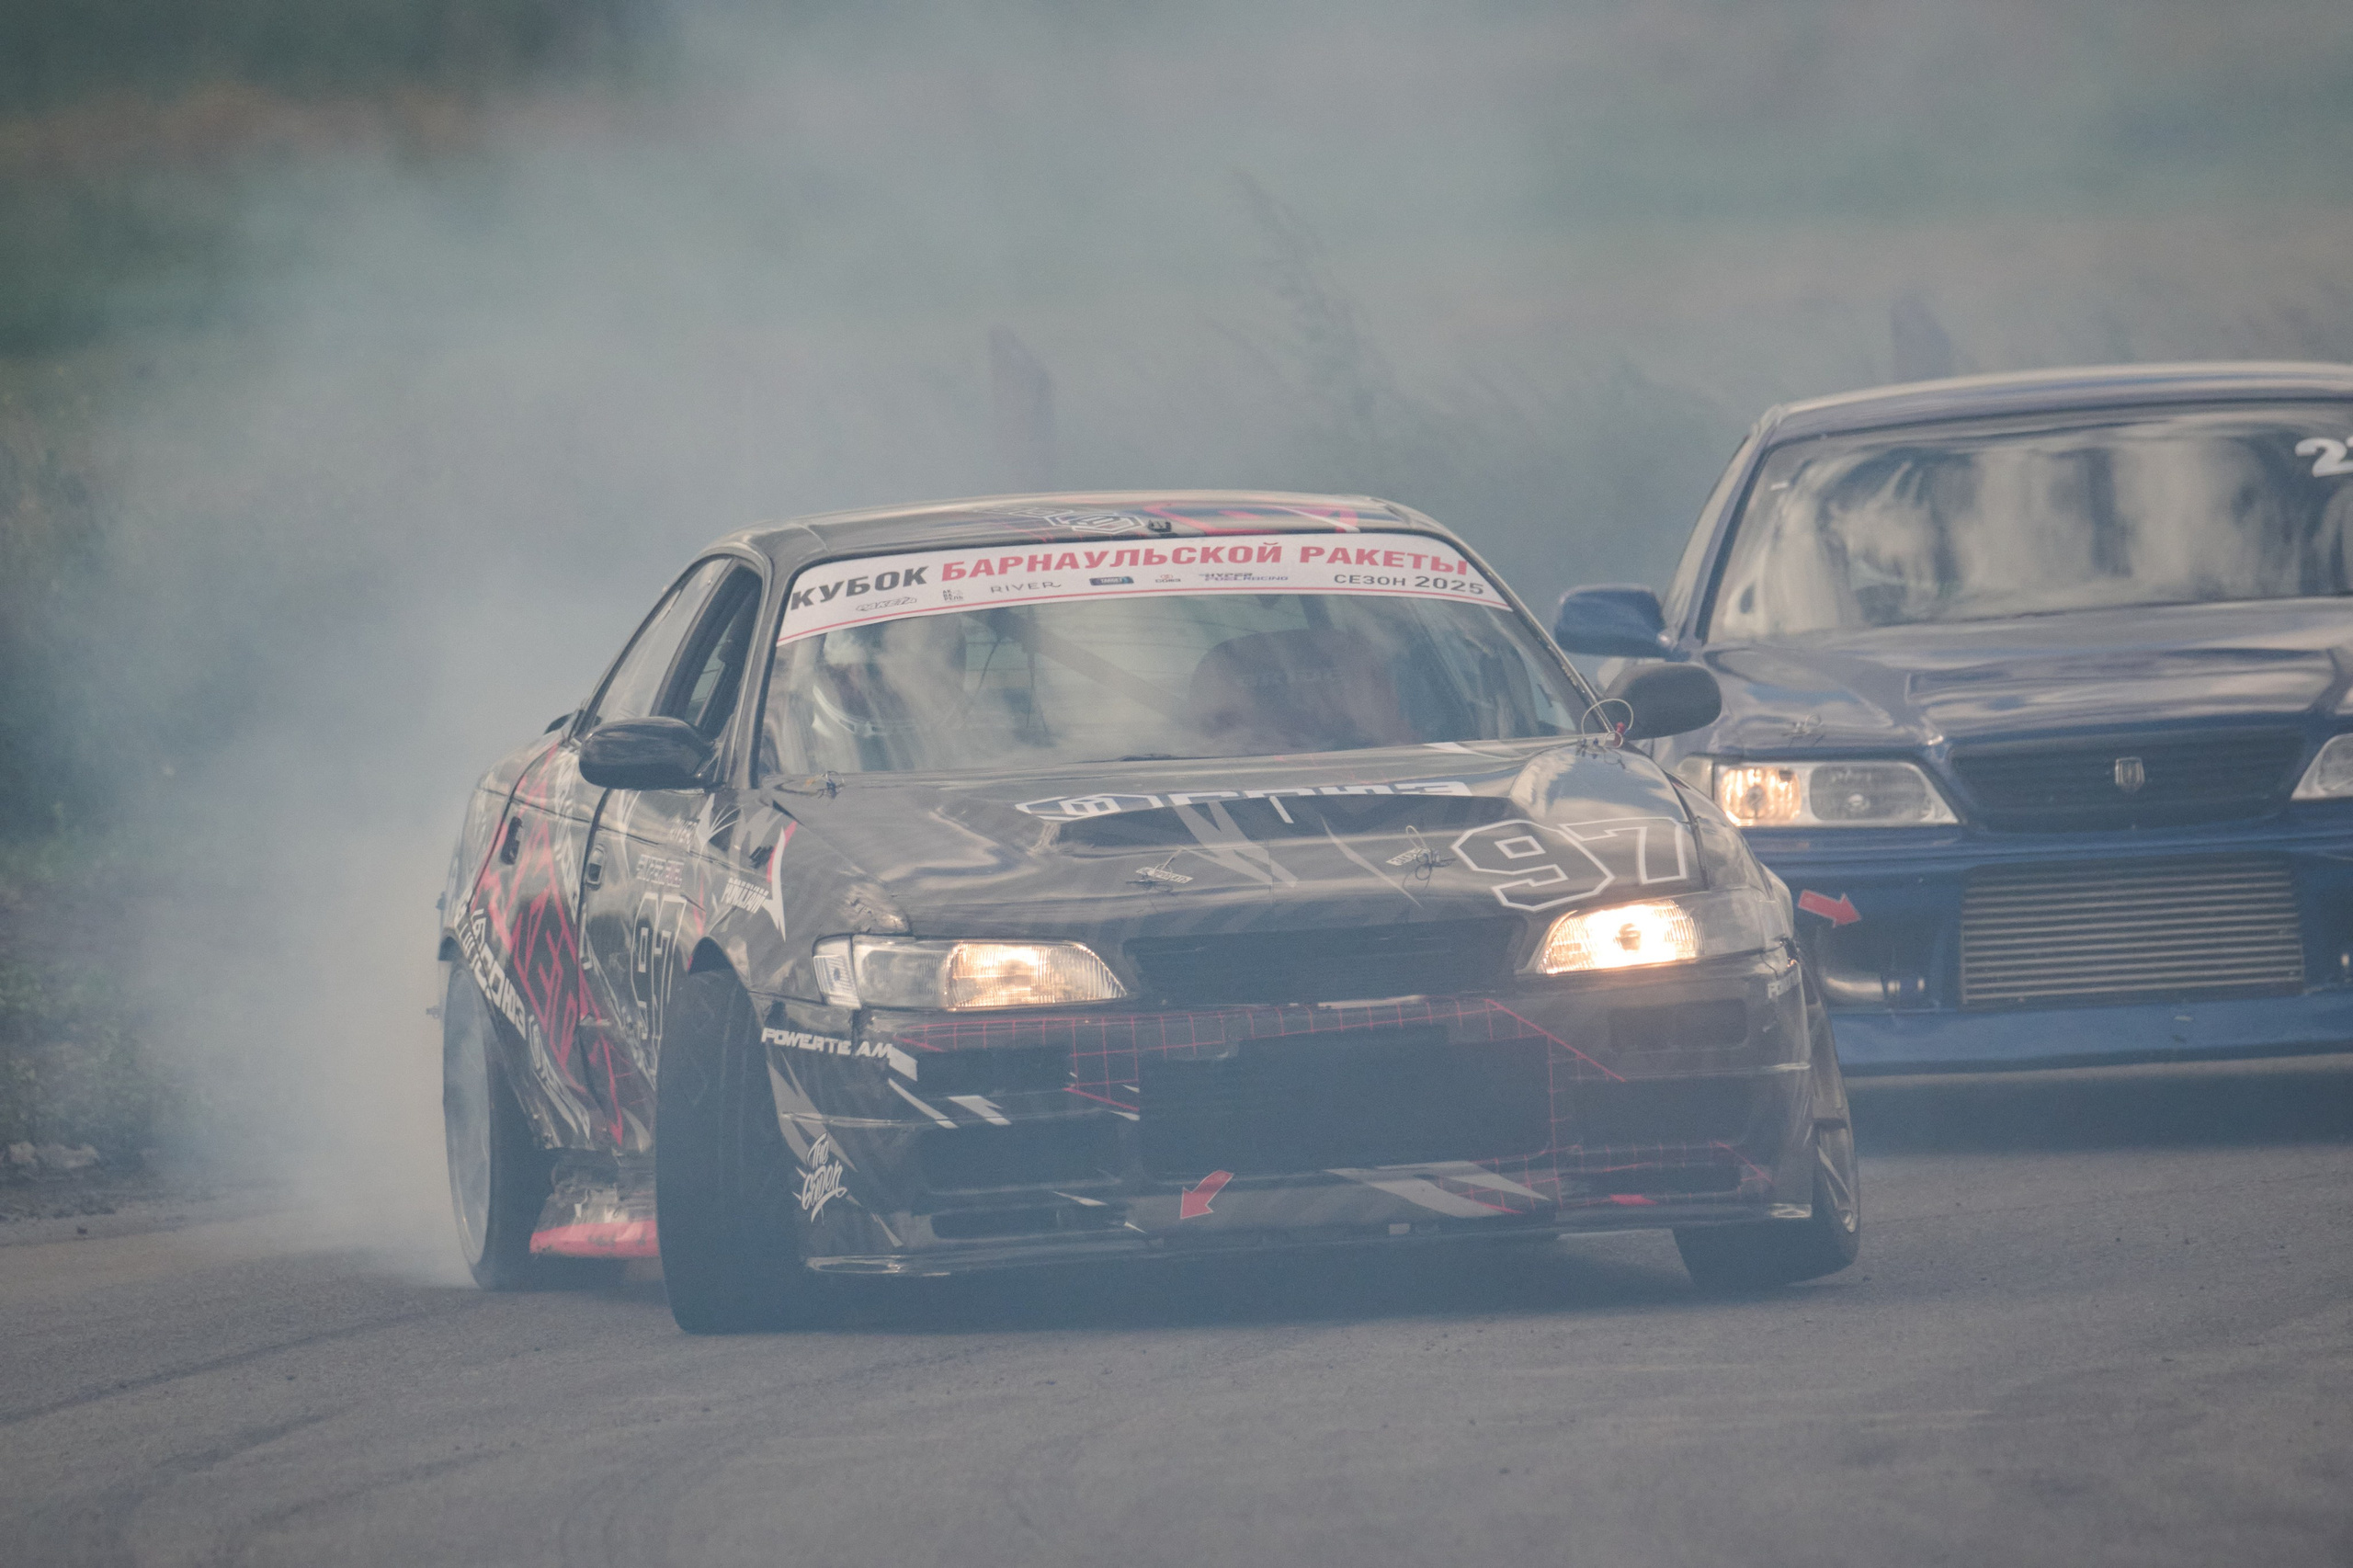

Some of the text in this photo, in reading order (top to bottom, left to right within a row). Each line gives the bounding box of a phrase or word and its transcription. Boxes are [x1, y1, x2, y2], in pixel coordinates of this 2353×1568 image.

[2294, 437, 2353, 478] 2
[790, 542, 1468, 610] КУБОК БАРНАУЛЬСКОЙ РАКЕТЫ
[990, 581, 1062, 594] RIVER
[1334, 574, 1484, 595] СЕЗОН 2025
[1450, 817, 1689, 912] 97
